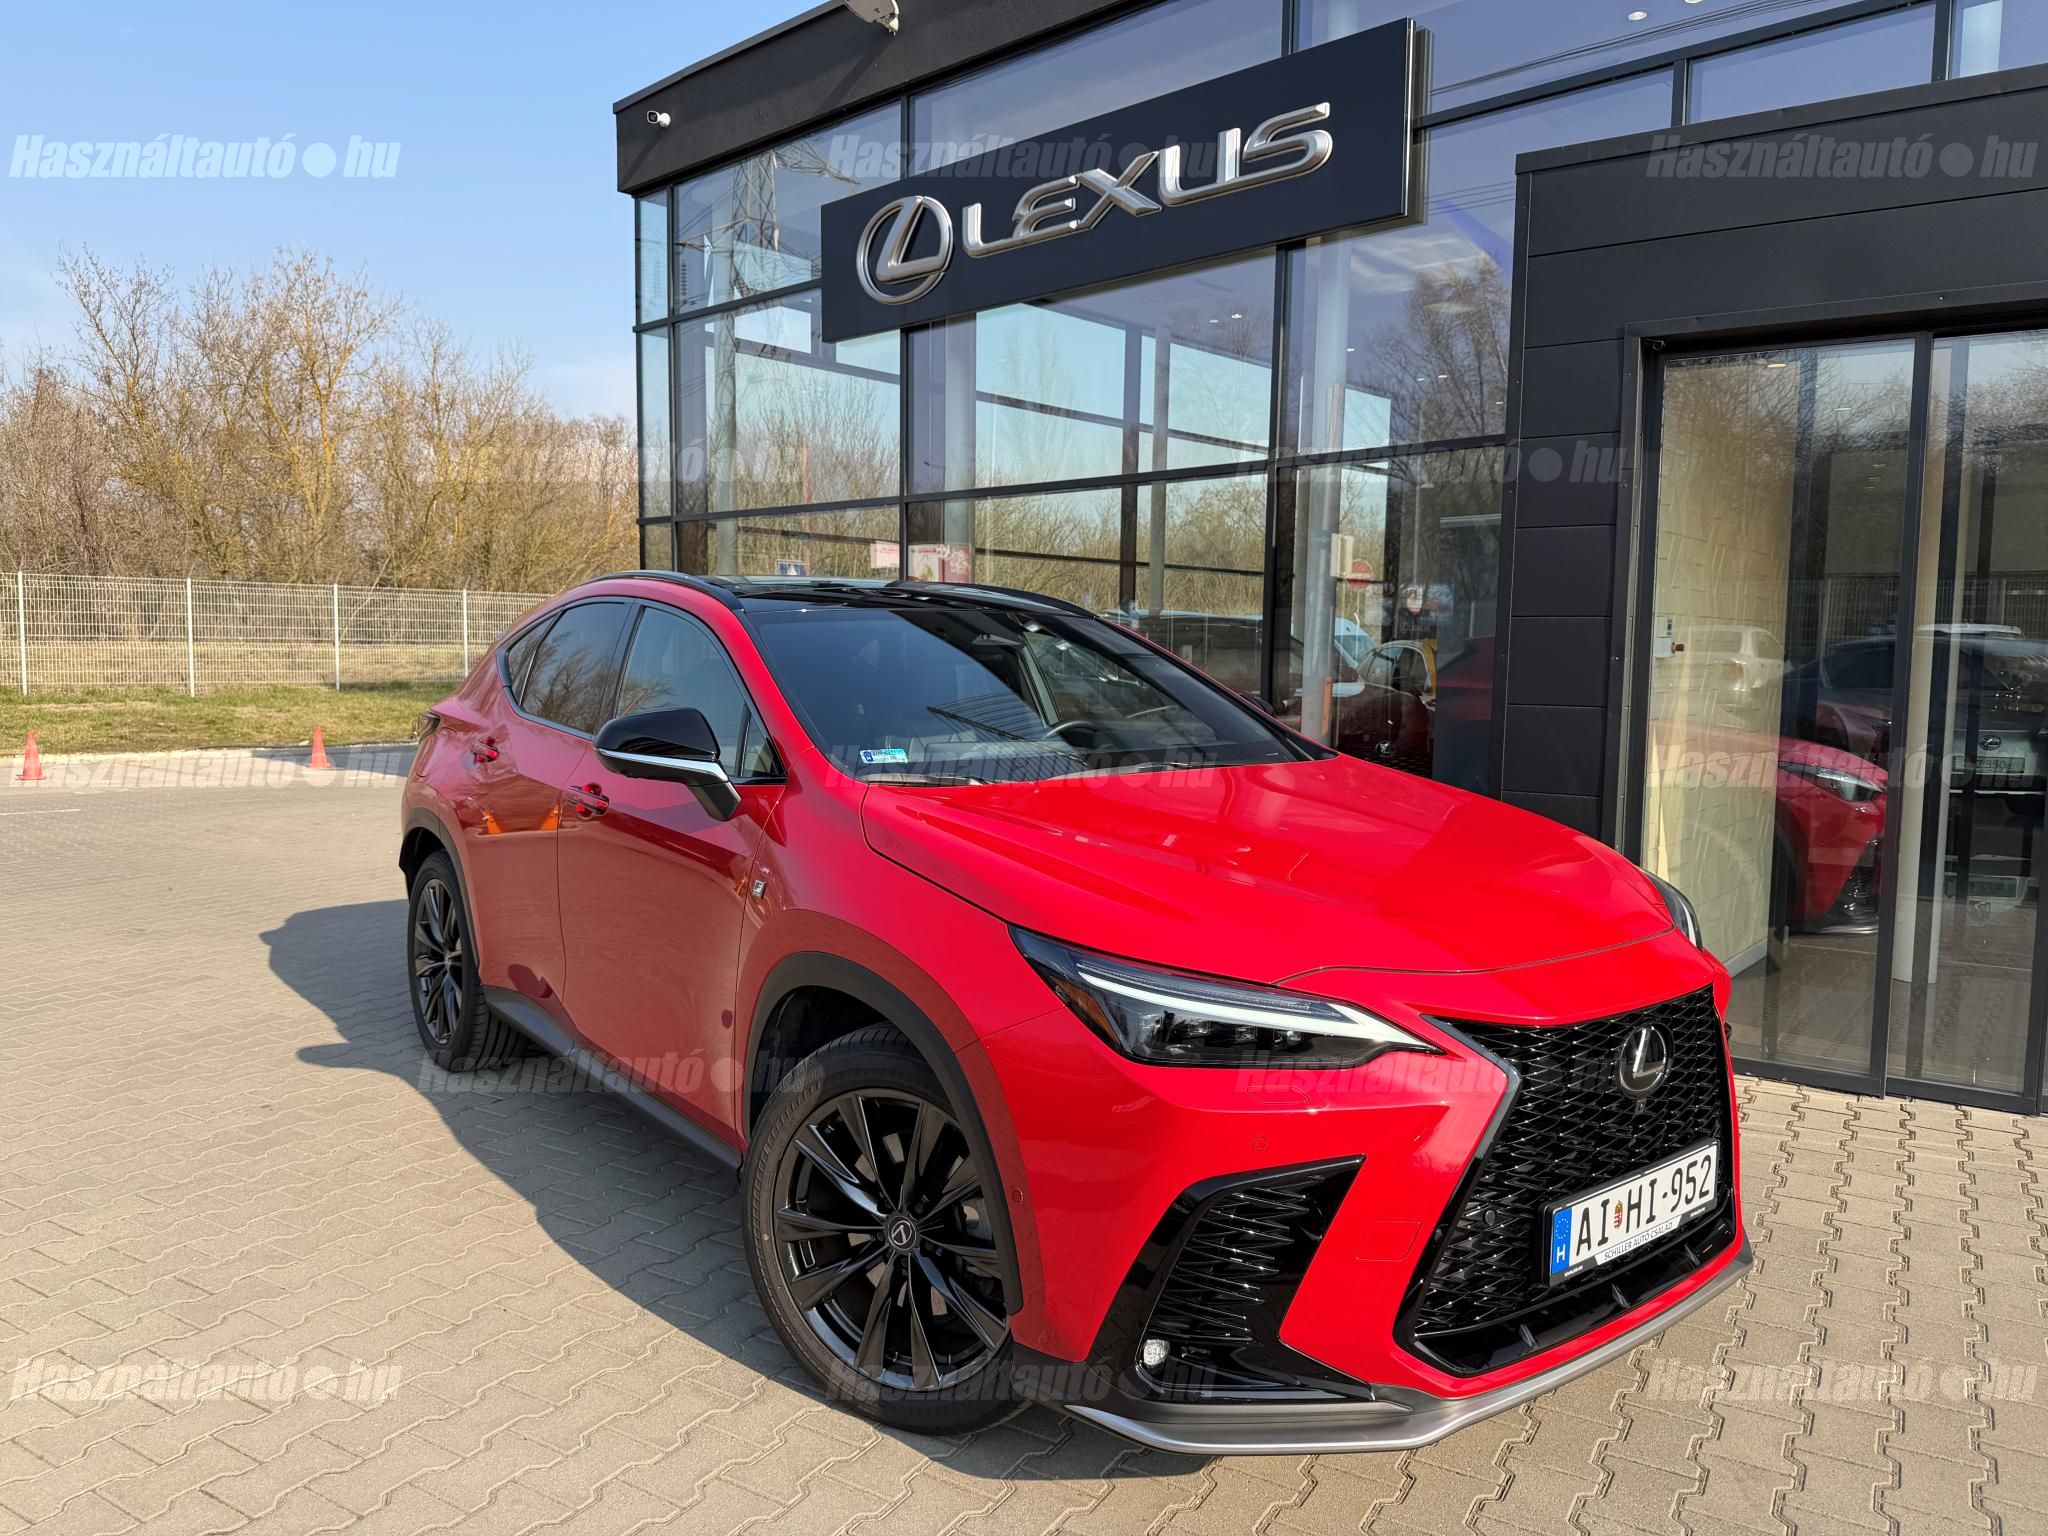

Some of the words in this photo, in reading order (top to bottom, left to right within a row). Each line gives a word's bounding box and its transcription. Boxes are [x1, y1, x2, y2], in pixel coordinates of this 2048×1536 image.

[961, 101, 1334, 259] LEXUS
[1576, 1198, 1611, 1257] AI
[1556, 1246, 1566, 1264] H
[1604, 1241, 1633, 1261] SCHILLER
